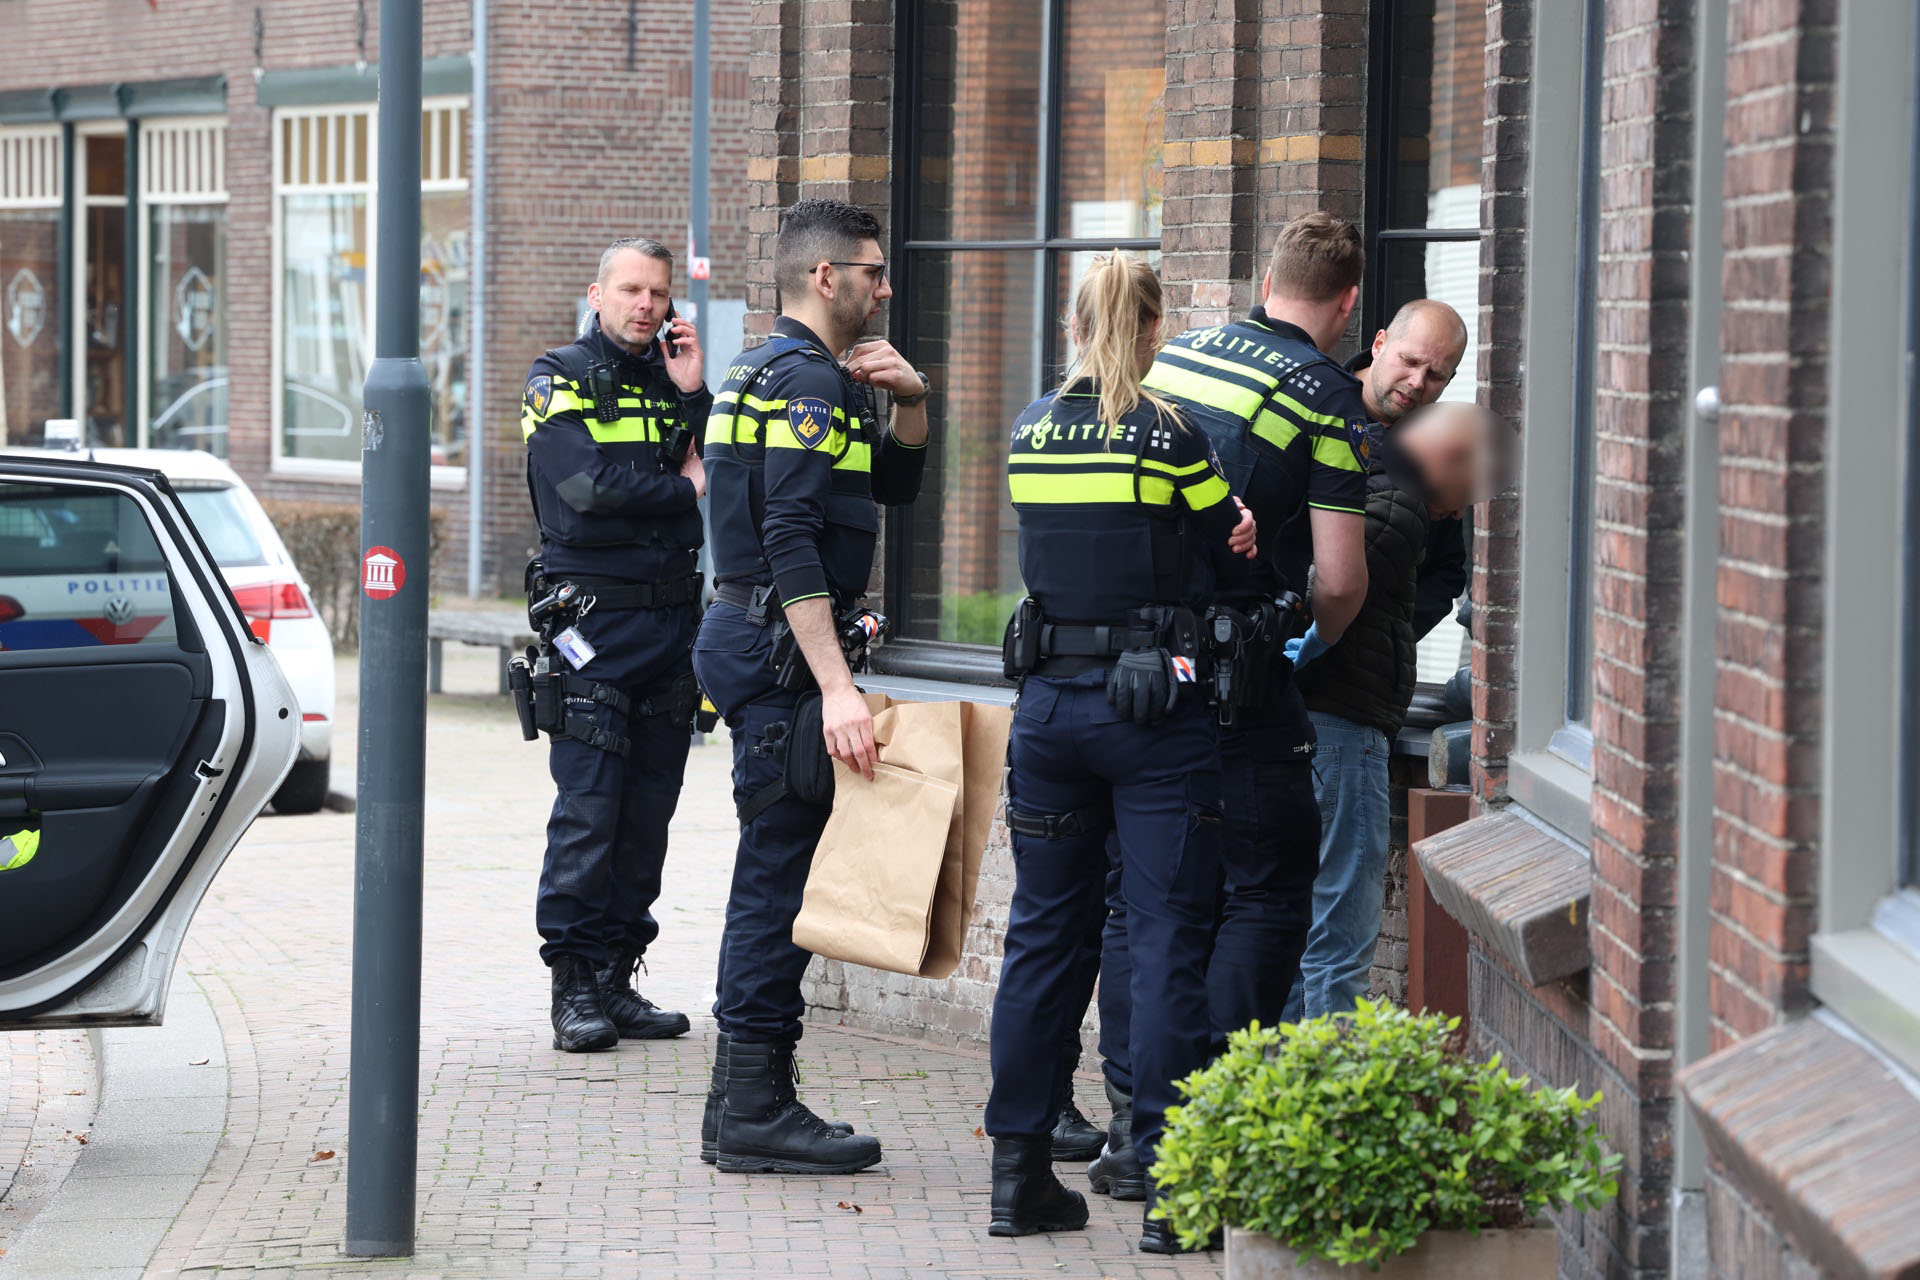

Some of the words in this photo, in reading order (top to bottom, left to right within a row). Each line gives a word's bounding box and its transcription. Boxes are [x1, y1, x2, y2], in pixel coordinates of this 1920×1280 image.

[1184, 325, 1284, 365] POLITIE
[791, 401, 827, 414] POLITIE
[1021, 411, 1126, 450] POLITIE
[68, 579, 168, 595] POLITIE
